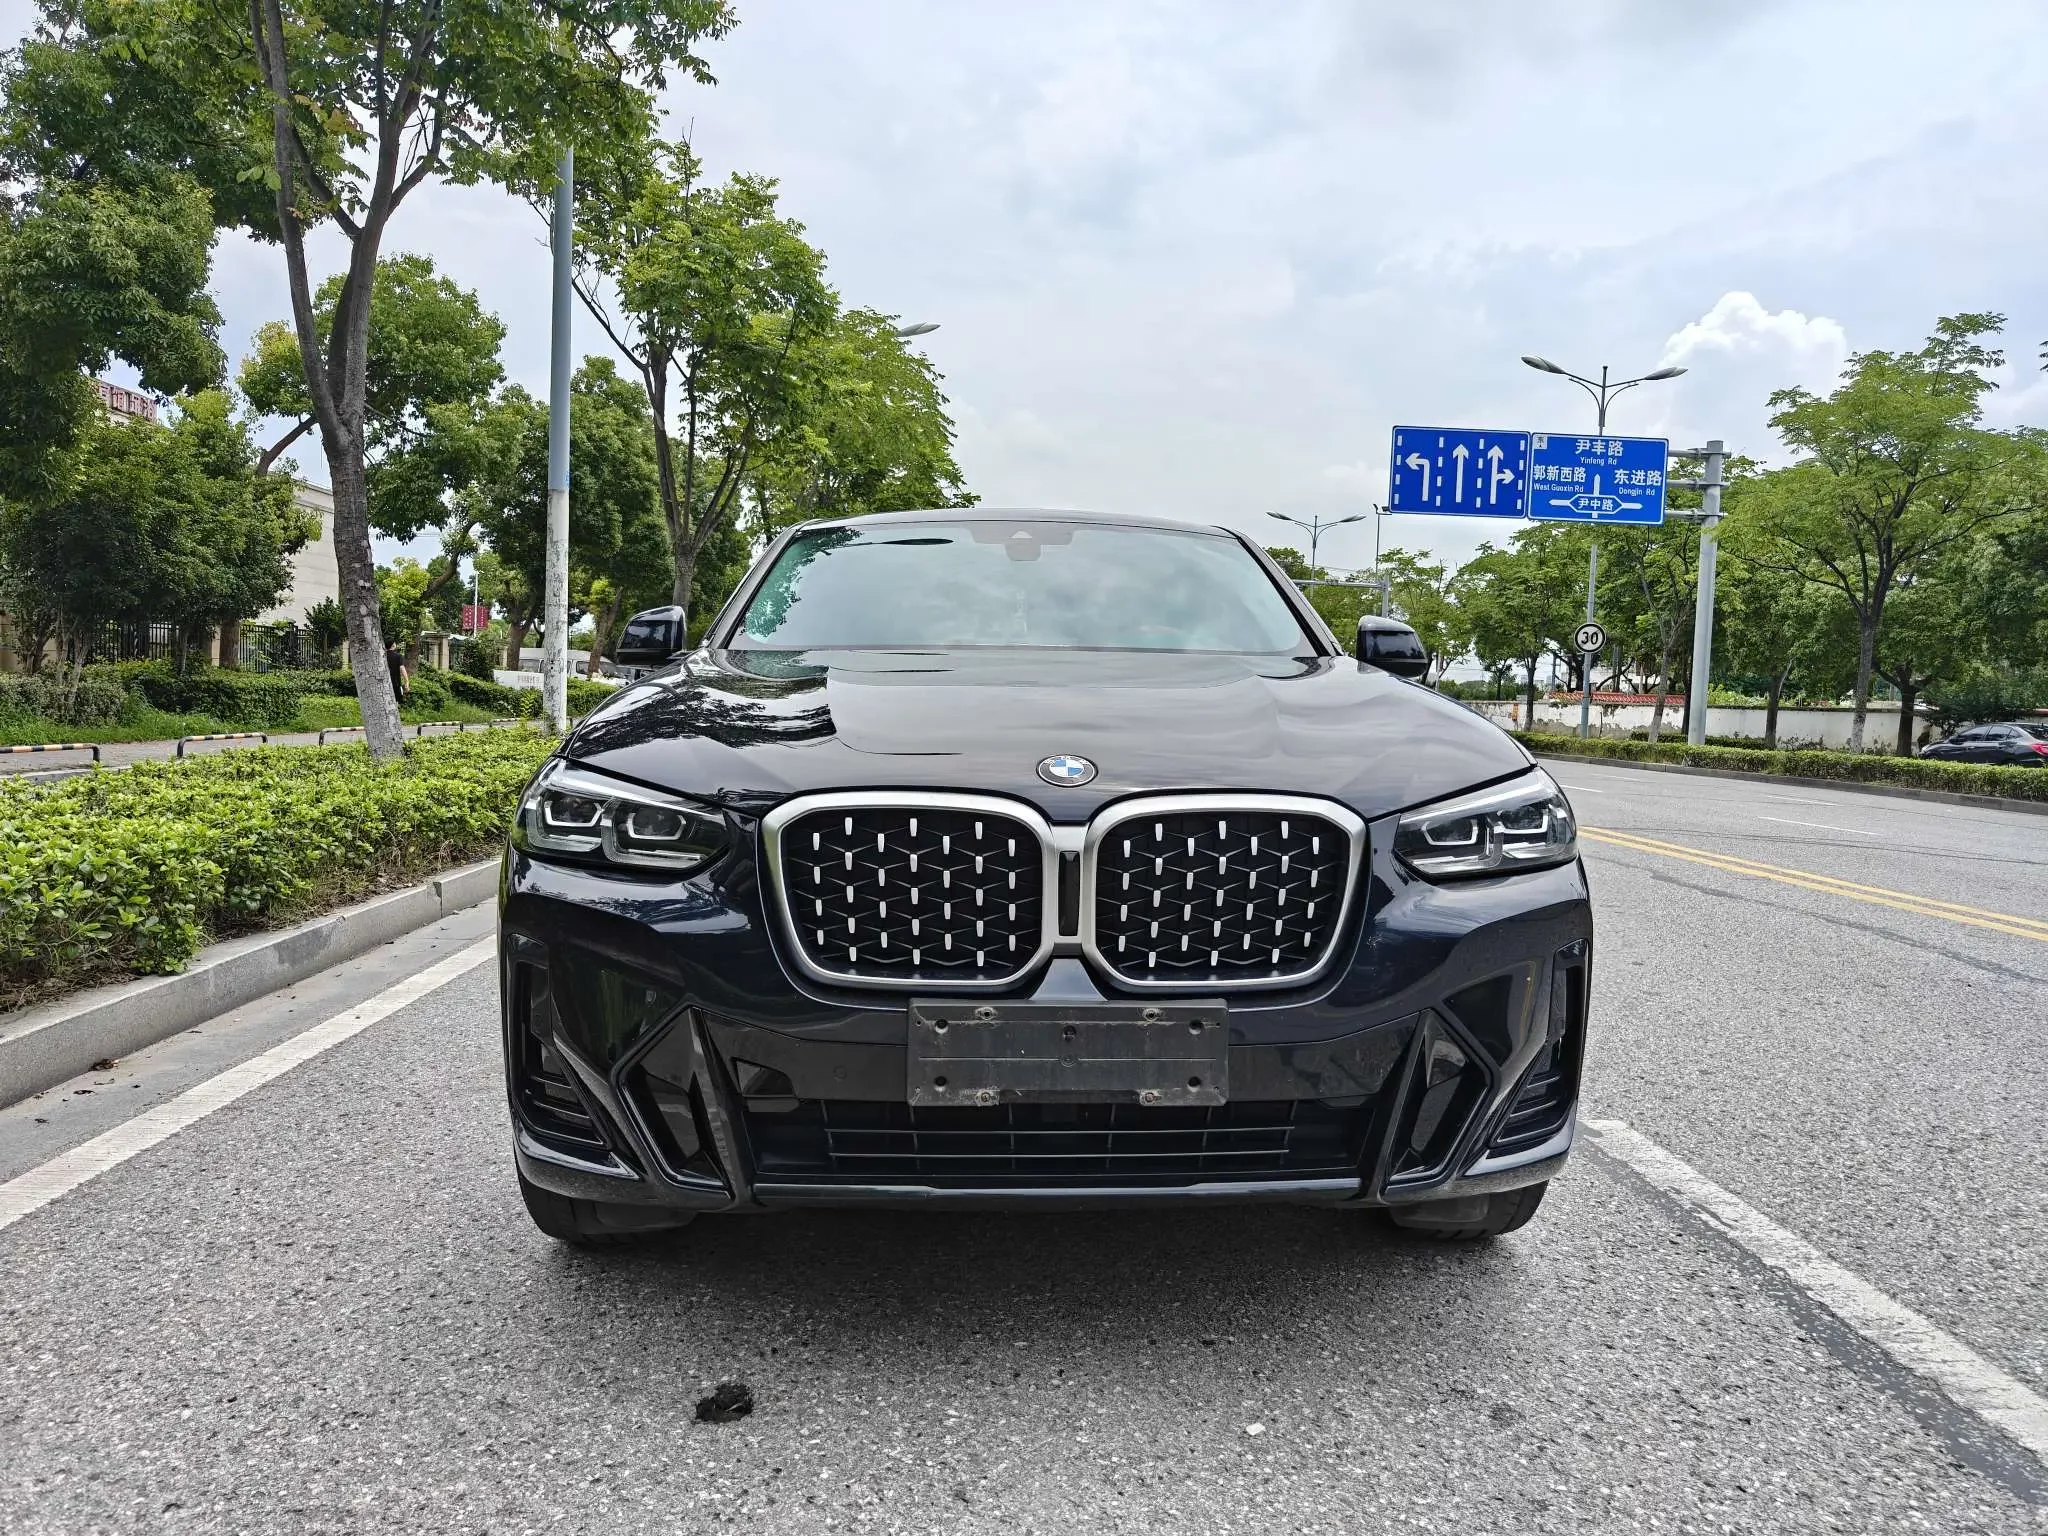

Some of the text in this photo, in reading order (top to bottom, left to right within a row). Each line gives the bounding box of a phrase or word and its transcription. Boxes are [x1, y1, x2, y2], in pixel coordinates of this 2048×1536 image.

[1575, 439, 1624, 456] 尹丰路
[1580, 457, 1605, 466] Yinfeng
[1533, 464, 1586, 482] 郭新西路
[1614, 469, 1662, 486] 东进路
[1534, 482, 1584, 493] West Guoxin Rd
[1619, 487, 1656, 497] Dongjin Rd
[1578, 498, 1613, 511] 尹中路
[1581, 631, 1599, 645] 30
